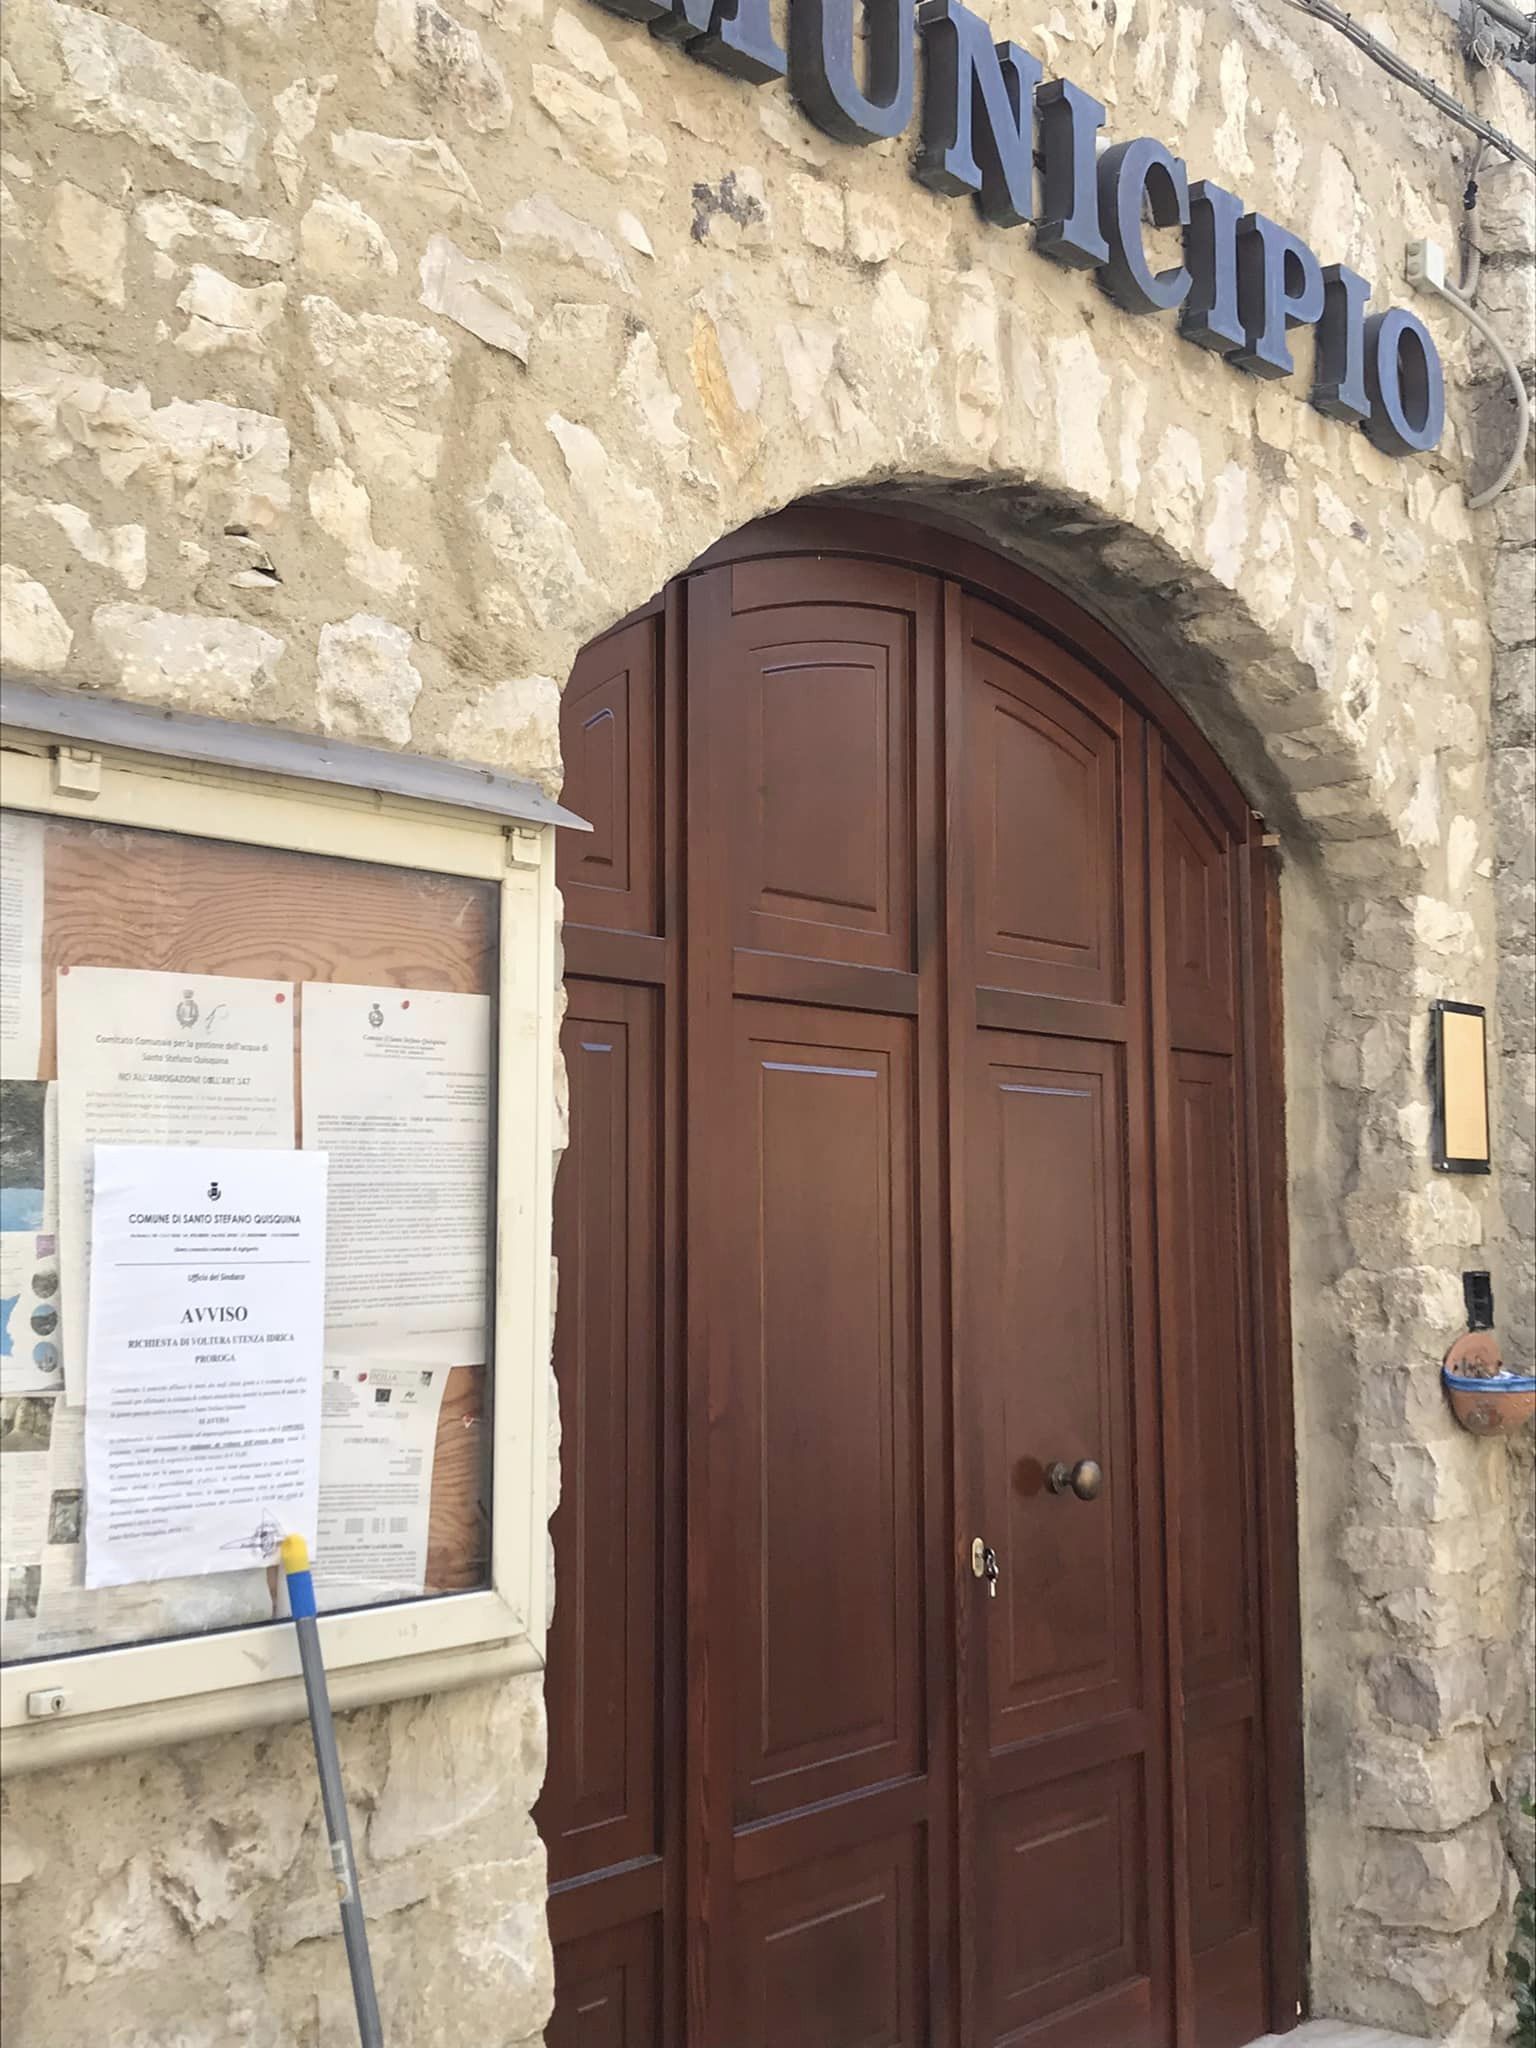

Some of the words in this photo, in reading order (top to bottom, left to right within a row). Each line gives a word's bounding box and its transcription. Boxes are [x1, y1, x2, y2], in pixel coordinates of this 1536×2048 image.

[173, 1039, 186, 1049] per
[195, 1041, 224, 1050] gestione
[142, 1052, 163, 1062] Santo
[164, 1054, 192, 1063] Stefano
[118, 1073, 131, 1081] NO
[128, 1213, 170, 1225] COMUNE
[171, 1213, 181, 1224] DI
[183, 1213, 212, 1225] SANTO
[213, 1213, 252, 1225] STEFANO
[253, 1213, 301, 1225] QUISQUINA
[187, 1273, 208, 1283] Ufficio
[209, 1272, 219, 1282] del
[220, 1273, 245, 1282] Sindaco
[180, 1305, 248, 1324] AVVISO
[127, 1338, 178, 1349] RICHIESTA
[179, 1338, 190, 1347] DI
[266, 1333, 294, 1343] IDRICA
[194, 1354, 236, 1364] PROROGA
